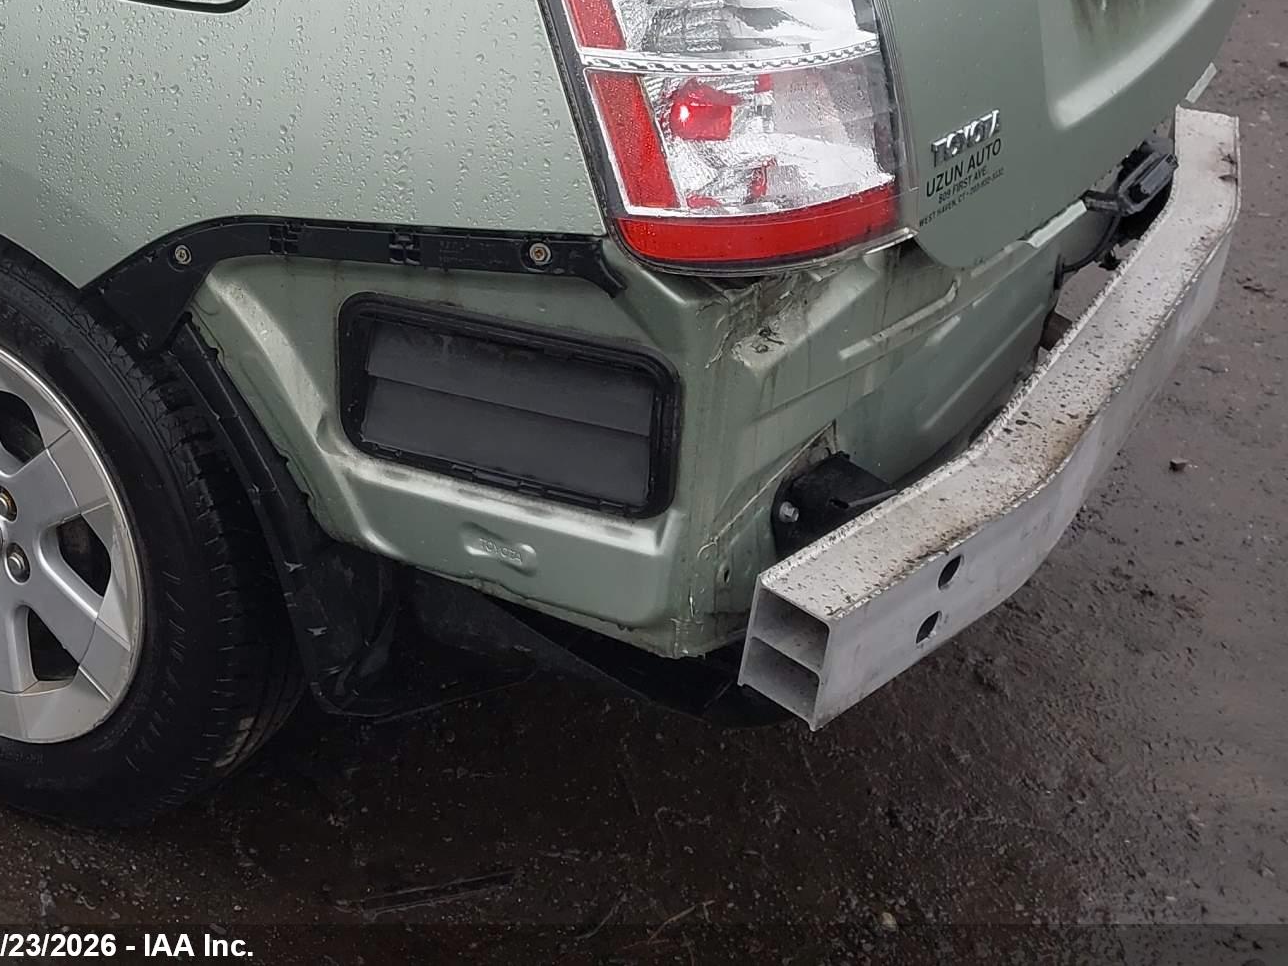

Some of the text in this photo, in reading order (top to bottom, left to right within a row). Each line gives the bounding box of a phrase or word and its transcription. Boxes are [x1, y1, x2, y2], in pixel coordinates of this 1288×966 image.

[926, 161, 964, 197] UZUN
[967, 138, 1001, 173] AUTO
[952, 175, 972, 195] FIRST
[974, 165, 987, 181] AVE
[919, 211, 936, 227] WEST
[479, 538, 523, 566] TOYOTA
